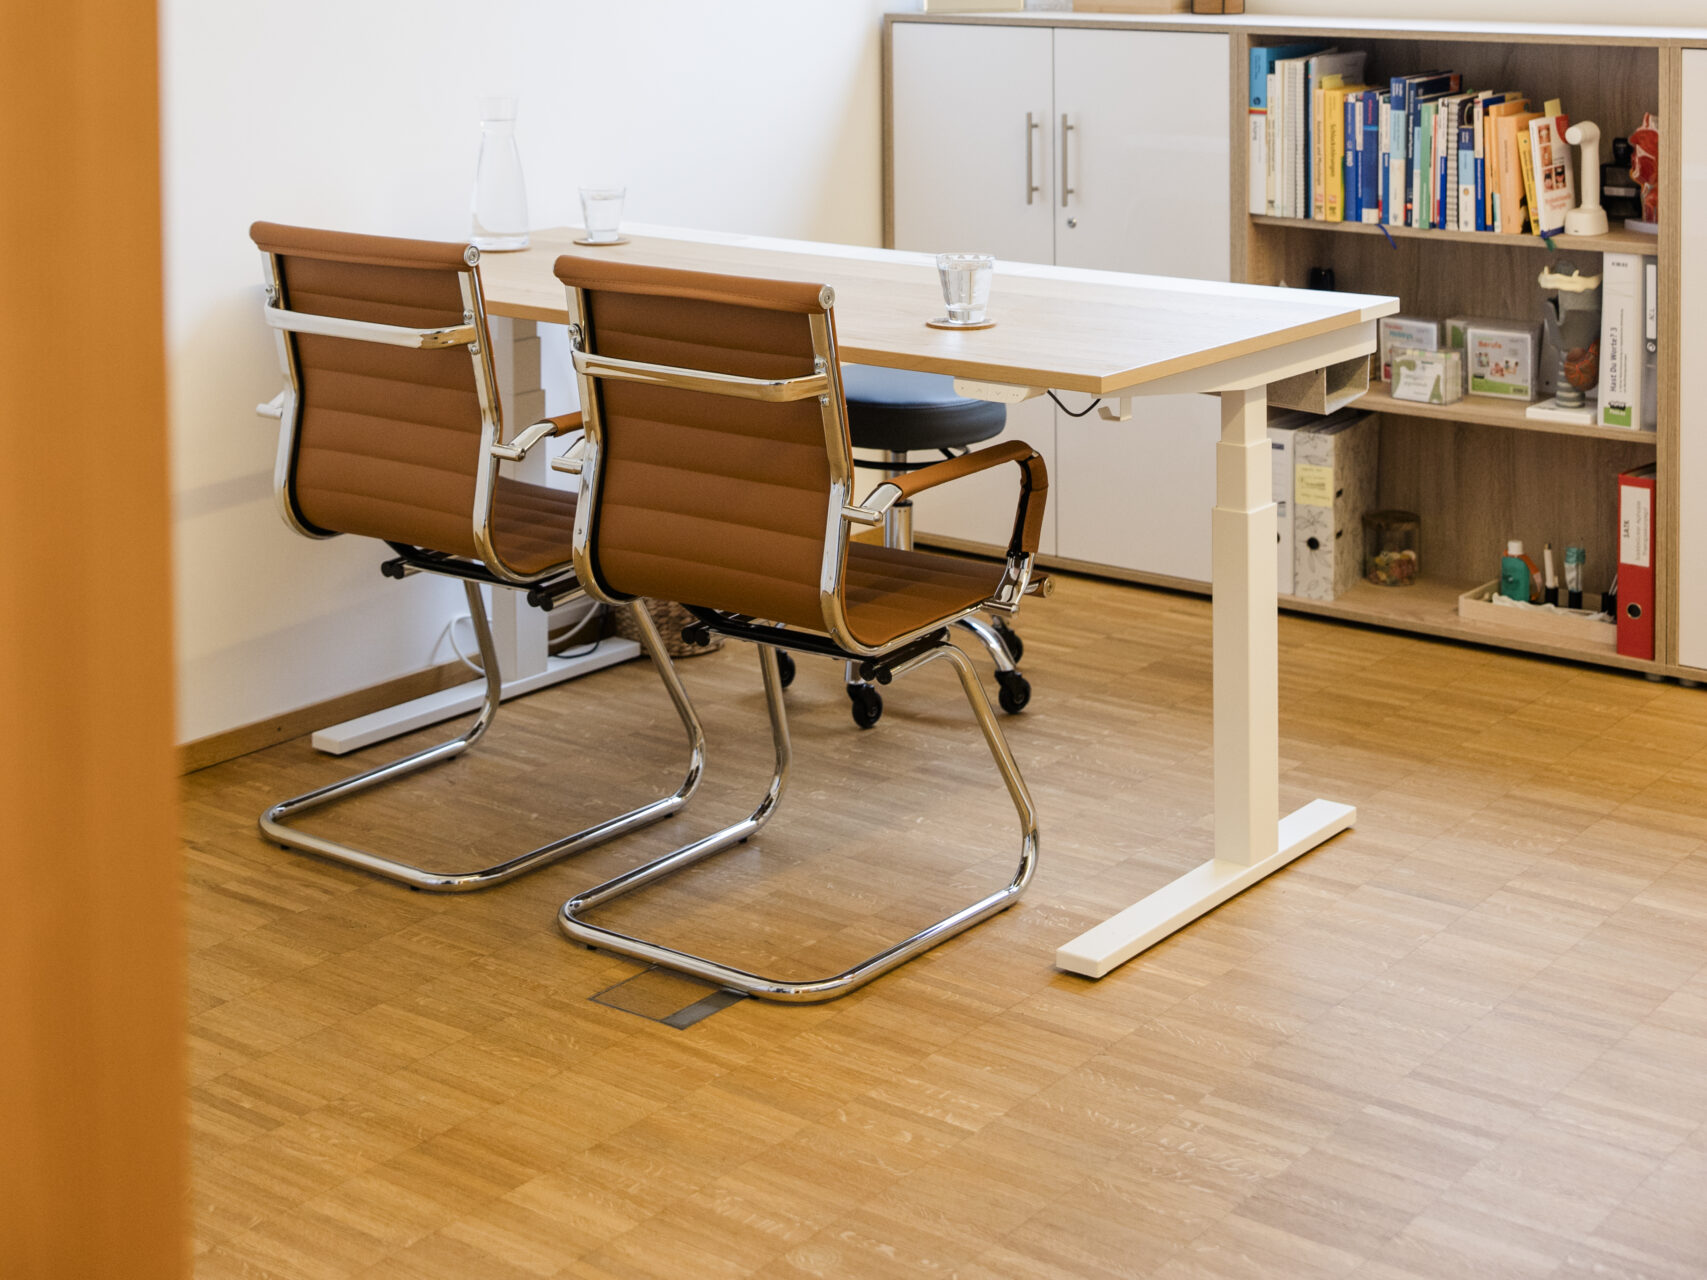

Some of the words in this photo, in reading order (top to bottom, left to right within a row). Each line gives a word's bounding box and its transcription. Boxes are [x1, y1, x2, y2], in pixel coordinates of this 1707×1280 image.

[1610, 333, 1618, 361] Worte?
[1609, 363, 1618, 373] Du
[1609, 375, 1618, 392] Hast
